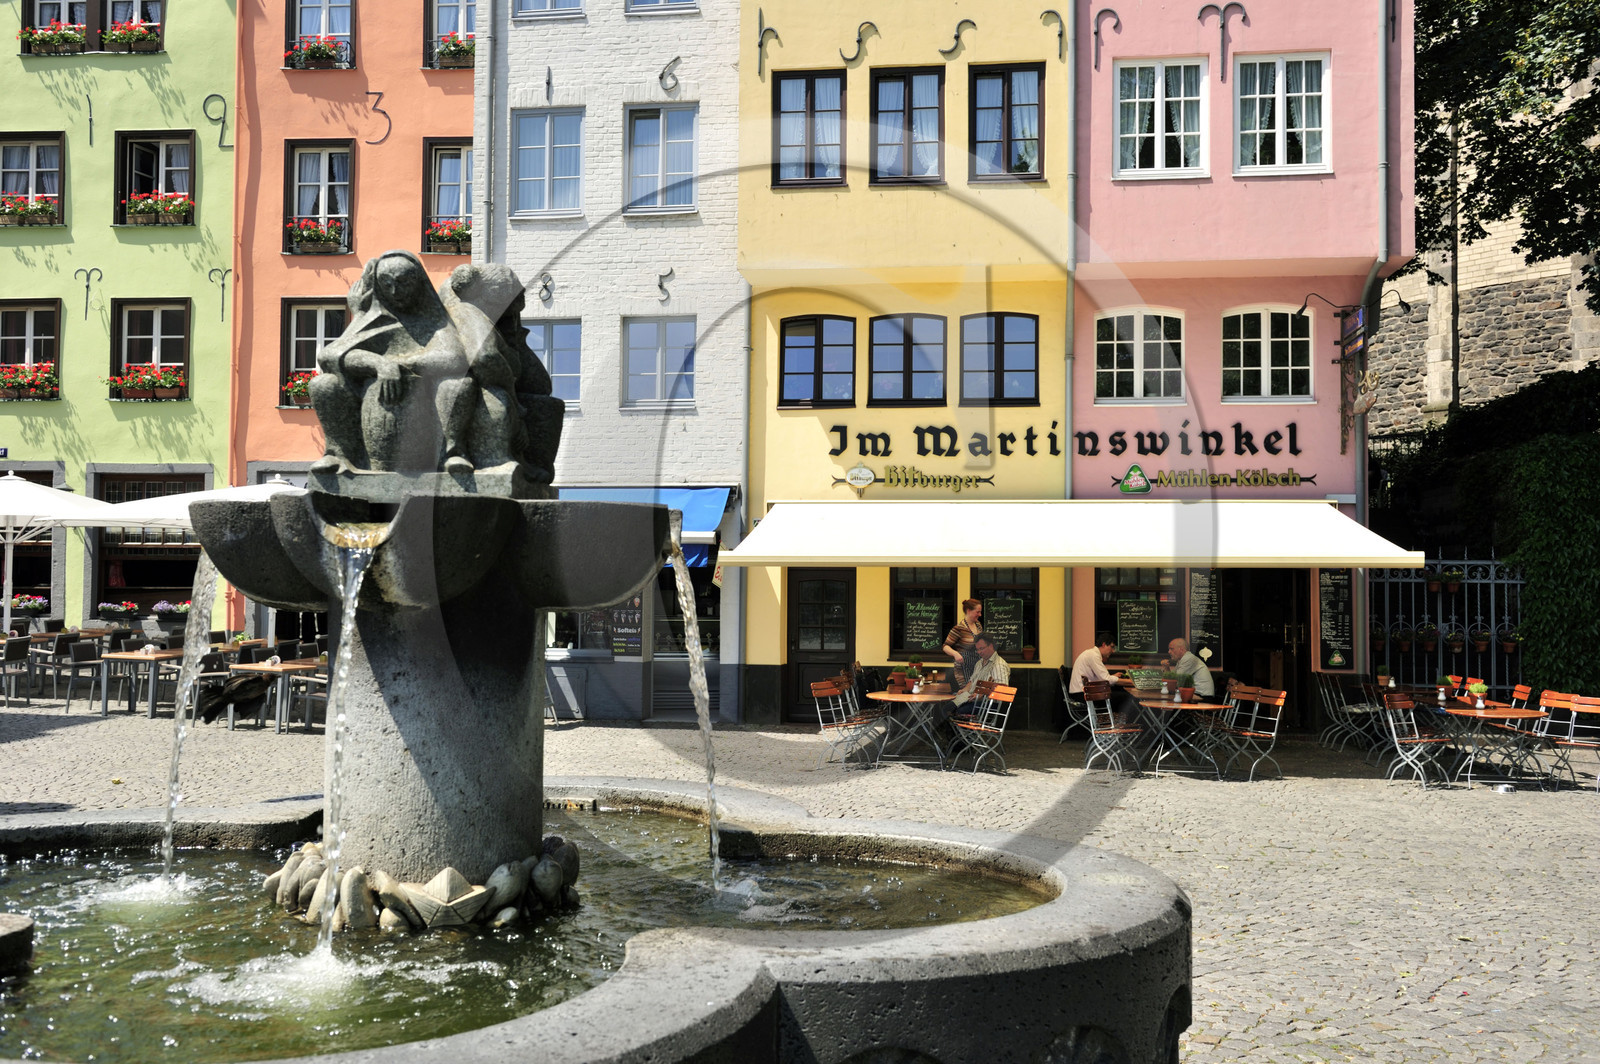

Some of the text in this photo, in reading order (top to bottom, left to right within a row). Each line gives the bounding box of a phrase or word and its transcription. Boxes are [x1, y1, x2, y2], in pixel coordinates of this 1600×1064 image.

[365, 91, 392, 145] 3
[829, 419, 1302, 457] Im Martinswinkel
[884, 465, 984, 493] Bitburger
[1157, 468, 1301, 488] Mühlen Kölsch
